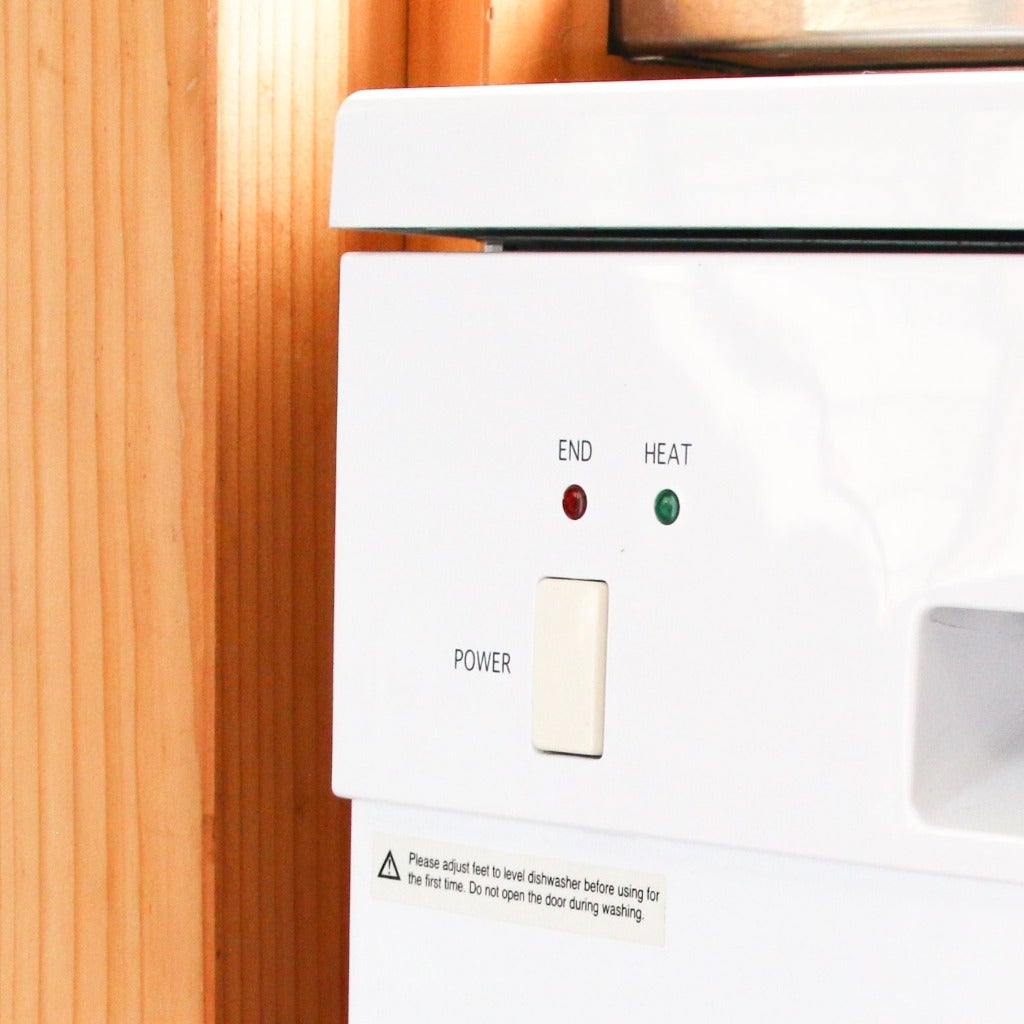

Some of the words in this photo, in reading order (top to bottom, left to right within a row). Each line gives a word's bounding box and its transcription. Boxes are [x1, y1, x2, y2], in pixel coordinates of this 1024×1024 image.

[558, 439, 593, 462] END
[644, 442, 693, 465] HEAT
[454, 648, 511, 674] POWER
[408, 851, 440, 870] Please
[442, 858, 470, 875] adjust
[472, 863, 490, 877] feet
[492, 866, 501, 879] to
[503, 866, 525, 882] level
[527, 870, 581, 891] dishwasher
[583, 877, 615, 896] before
[617, 885, 644, 903] using
[646, 887, 660, 902] for
[408, 872, 422, 887] the
[425, 874, 442, 890] first
[444, 877, 466, 893] time.
[469, 881, 482, 896] Do
[485, 884, 500, 898] not
[501, 889, 525, 903] open
[528, 890, 542, 905] the
[545, 893, 567, 909] door
[569, 896, 599, 916] during
[602, 902, 645, 923] washing.
